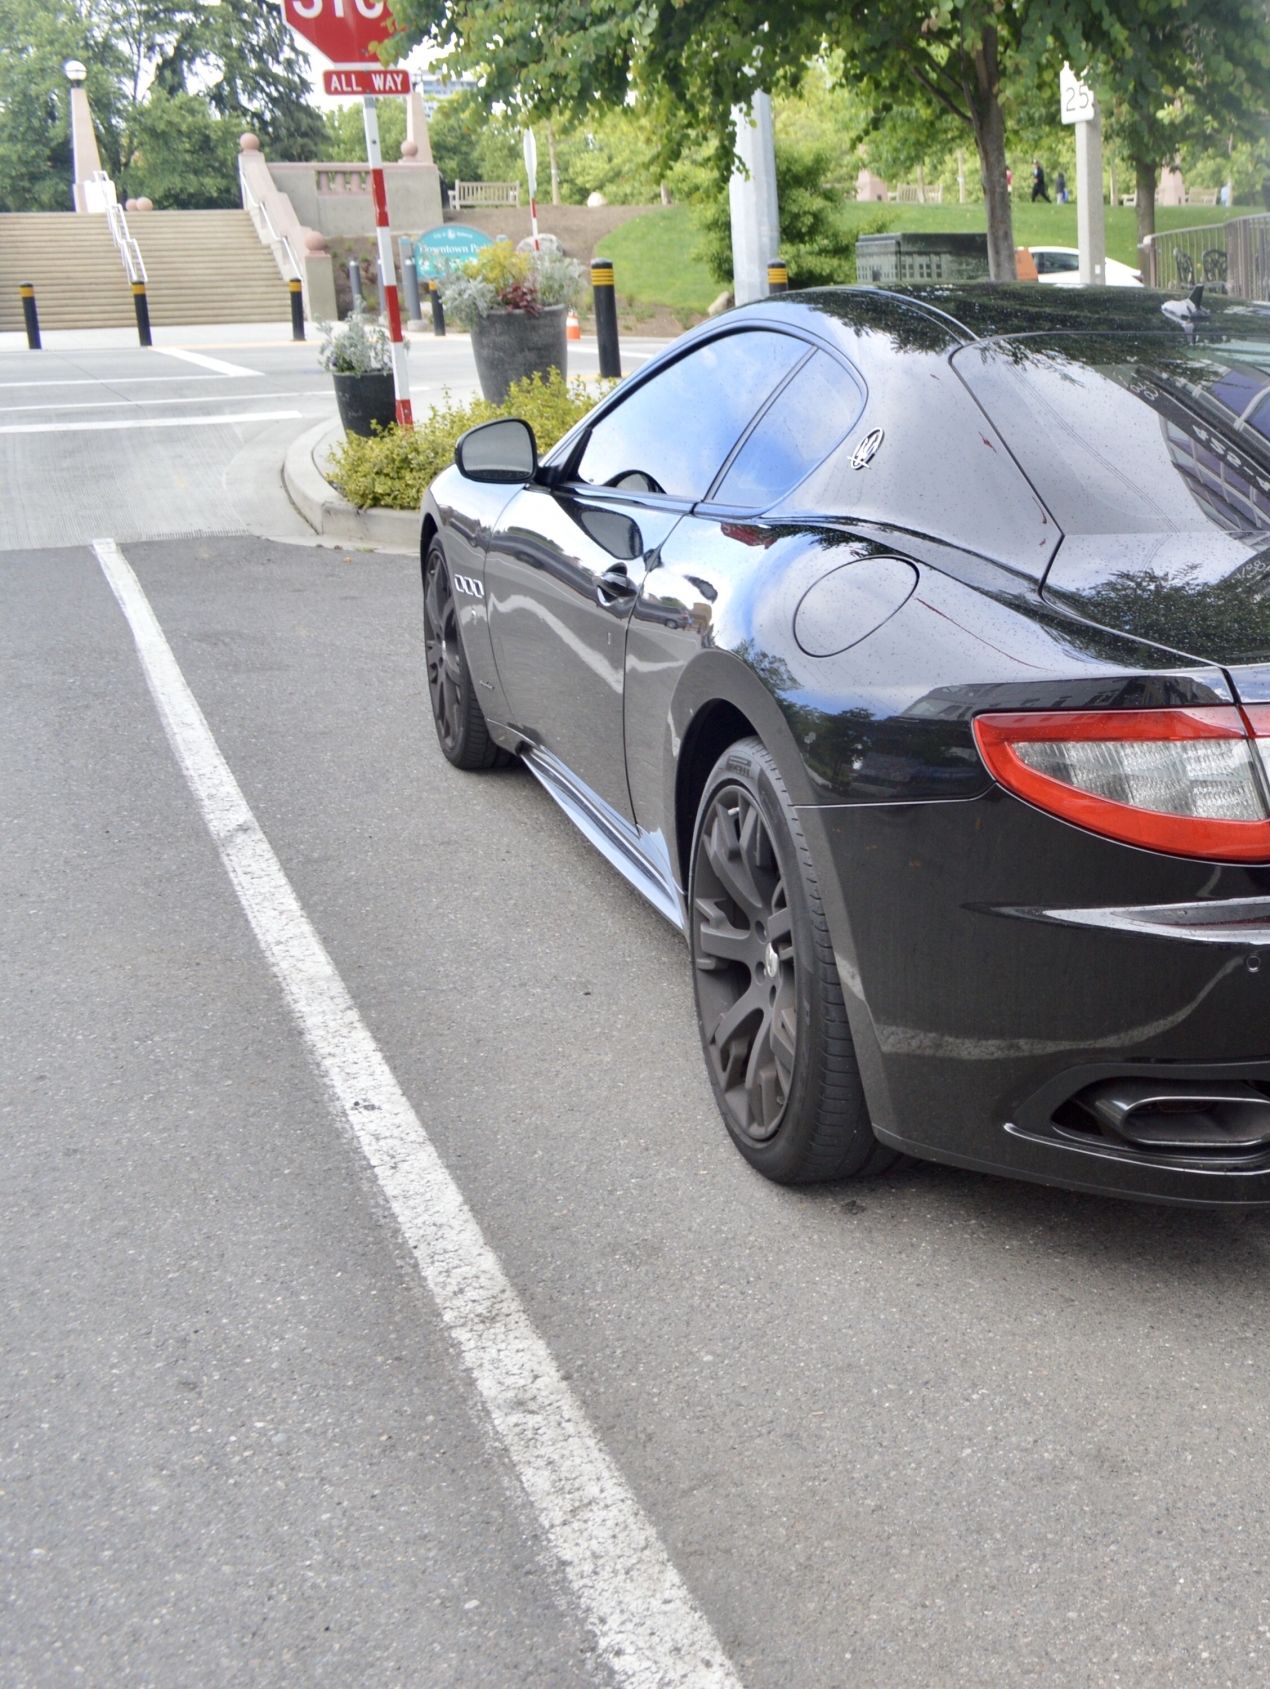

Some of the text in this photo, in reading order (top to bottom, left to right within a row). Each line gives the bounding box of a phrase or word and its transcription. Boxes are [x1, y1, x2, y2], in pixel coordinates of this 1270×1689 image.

[331, 73, 403, 91] ALL WAY
[1066, 85, 1089, 112] 25
